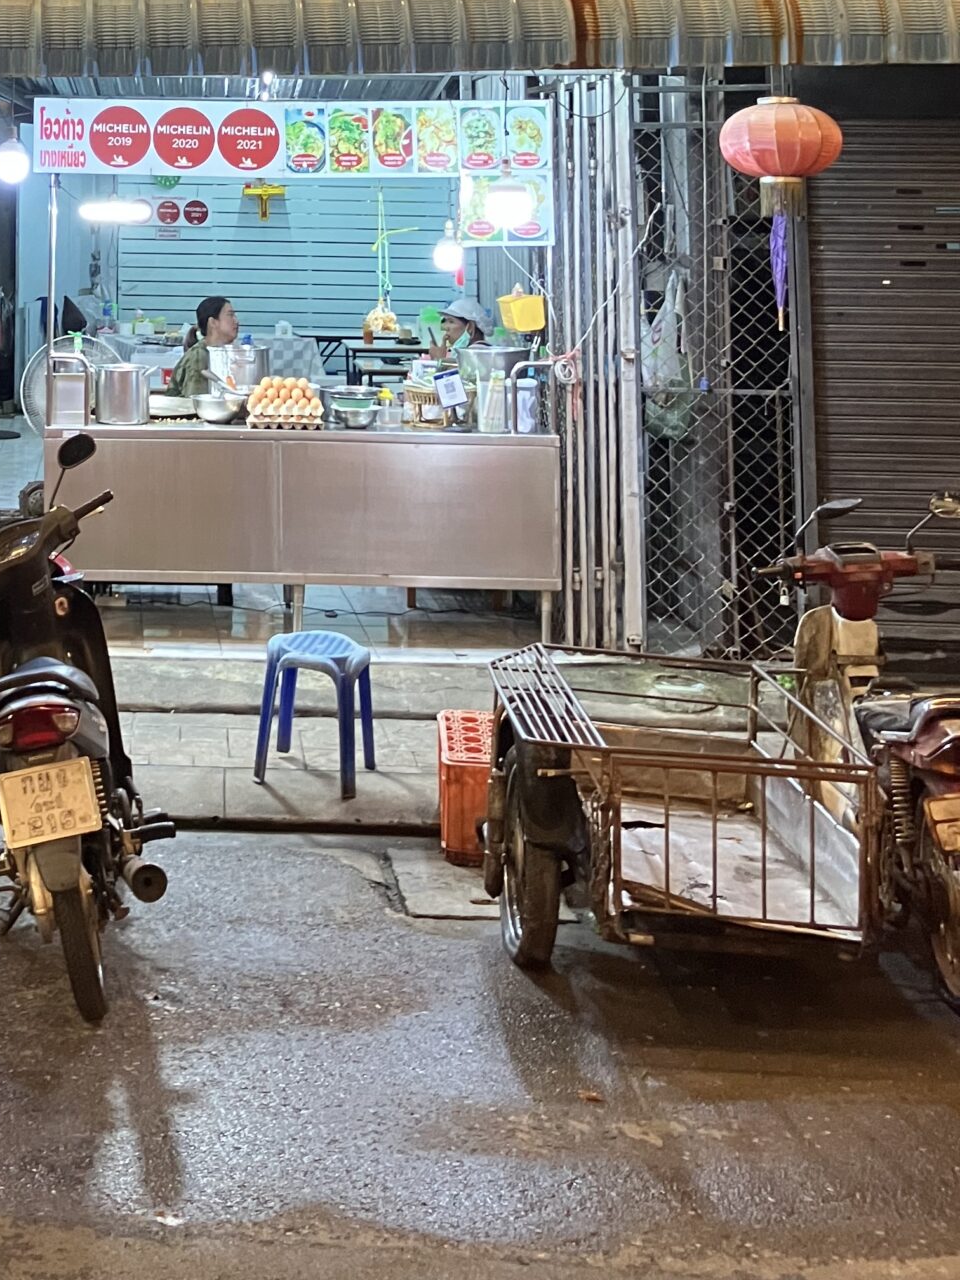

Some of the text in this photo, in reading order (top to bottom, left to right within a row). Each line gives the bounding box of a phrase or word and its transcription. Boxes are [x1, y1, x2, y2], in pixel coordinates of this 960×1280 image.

[40, 106, 84, 141] โอวต้าว
[93, 123, 147, 134] MICHELIN
[157, 124, 211, 136] MICHELIN
[221, 125, 276, 137] MICHELIN
[107, 136, 132, 146] 2019
[171, 138, 199, 149] 2020
[236, 139, 263, 150] 2021
[40, 143, 86, 168] บางเหนียว
